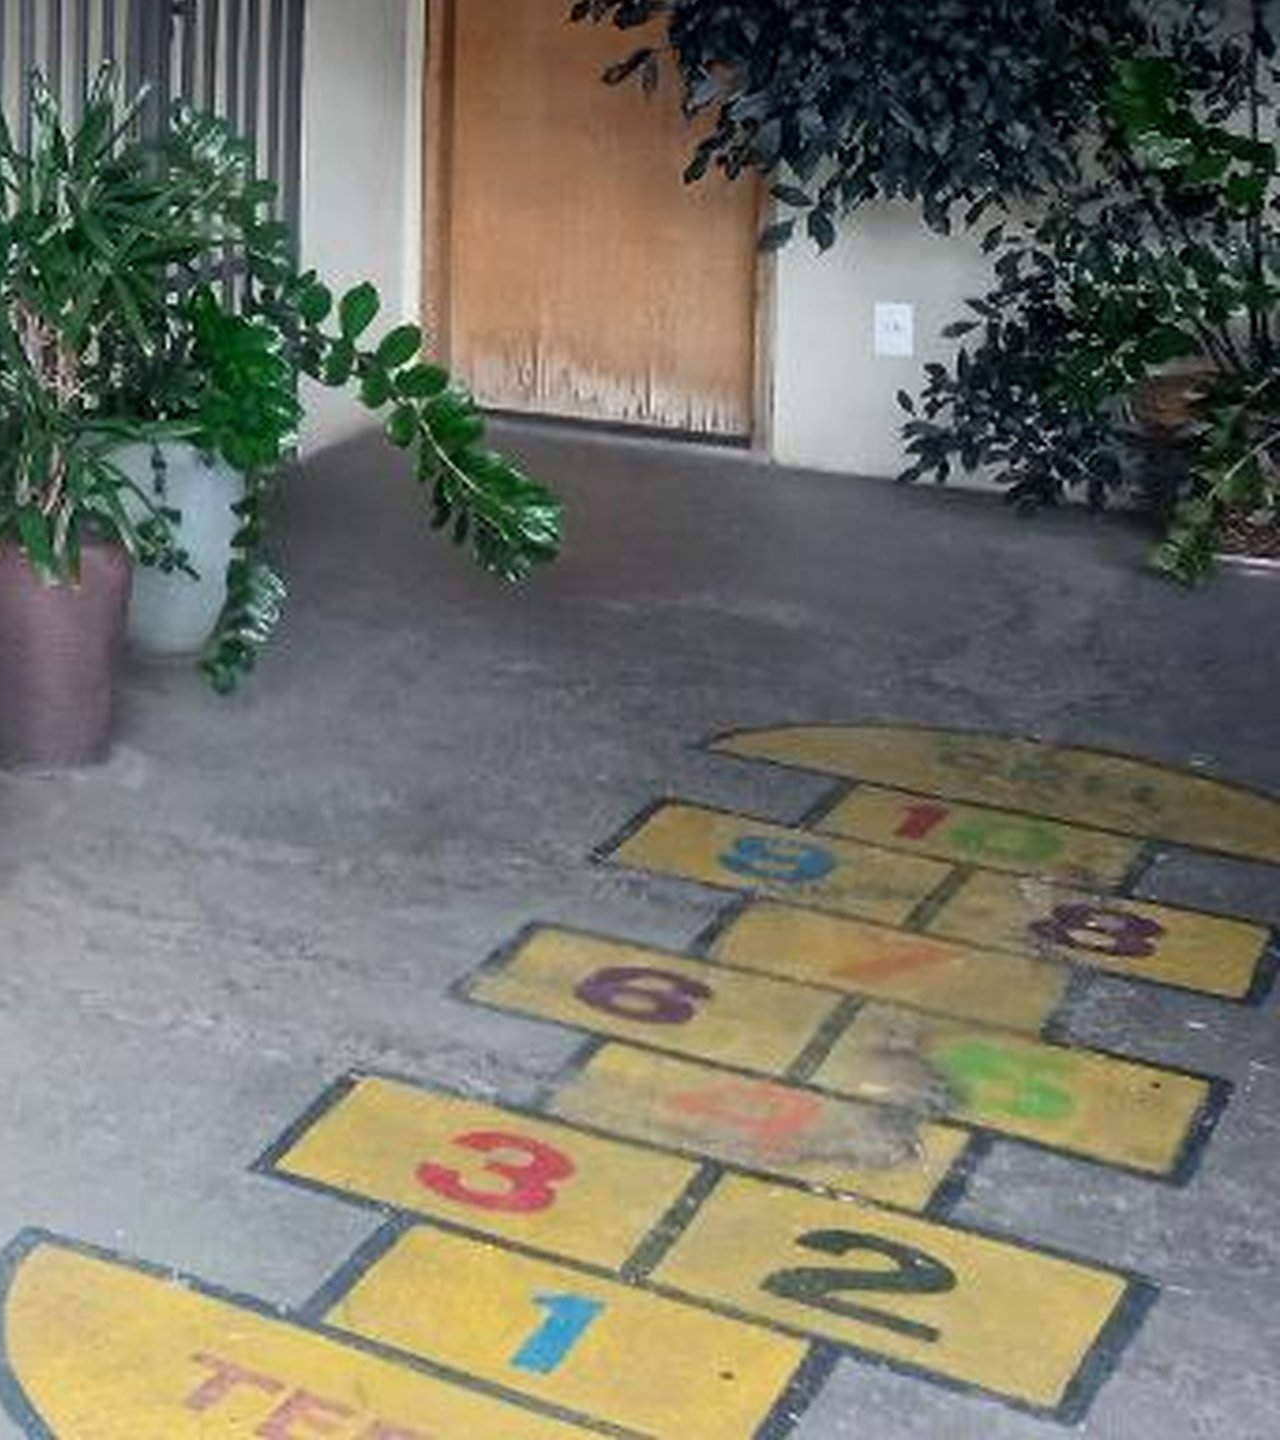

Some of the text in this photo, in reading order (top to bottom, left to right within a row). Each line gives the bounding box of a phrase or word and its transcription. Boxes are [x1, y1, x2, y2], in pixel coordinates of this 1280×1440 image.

[718, 835, 836, 886] 9
[892, 799, 1065, 866] 10
[1028, 900, 1168, 956] 8
[575, 964, 712, 1024] 6
[416, 1129, 575, 1216] 3
[759, 1228, 958, 1343] 2
[511, 1290, 604, 1375] 1
